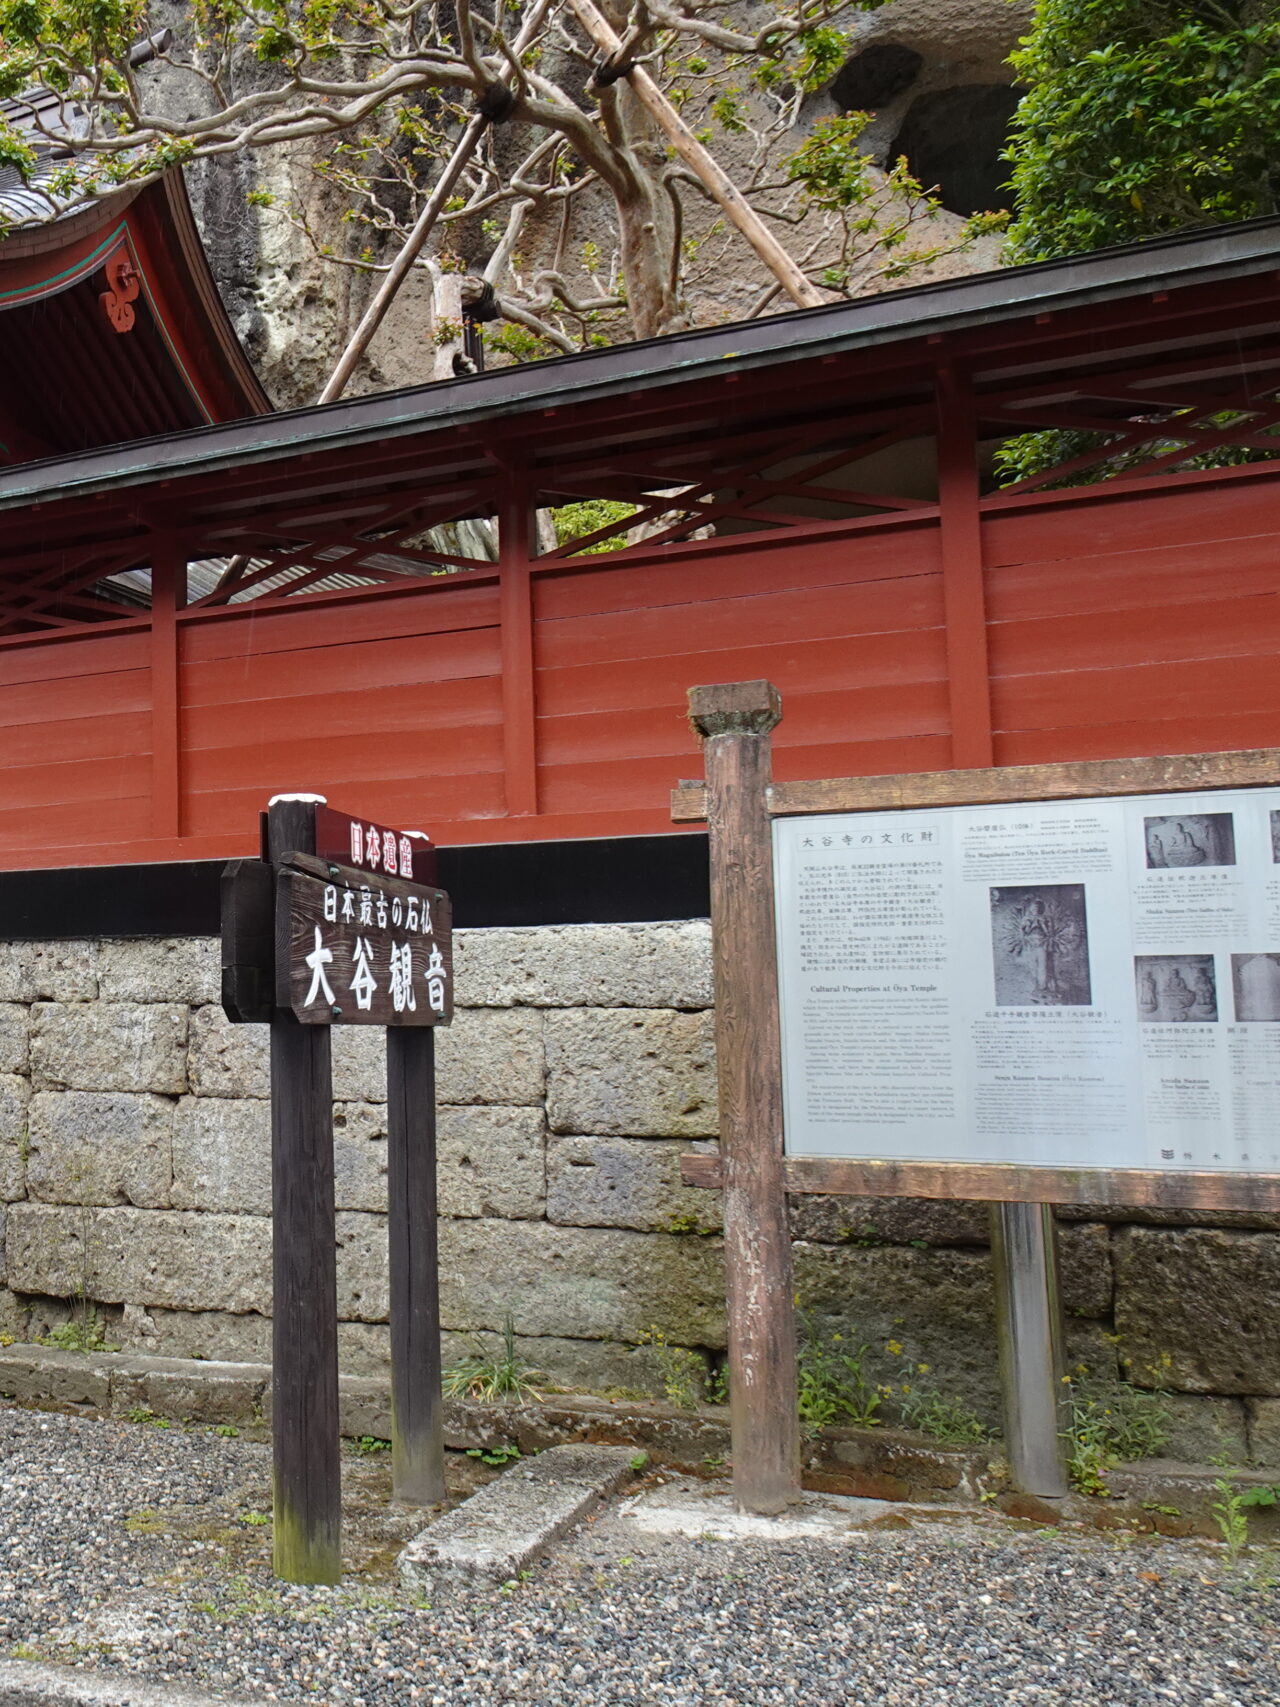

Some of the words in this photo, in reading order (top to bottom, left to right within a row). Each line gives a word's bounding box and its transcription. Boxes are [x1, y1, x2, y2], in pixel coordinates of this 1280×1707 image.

[350, 820, 414, 879] 日本遺産
[802, 831, 934, 848] 大谷寺の文化財
[323, 880, 434, 936] 日本最古の石仏
[303, 924, 448, 1013] 大谷観音
[810, 984, 840, 993] Cultural
[842, 985, 881, 995] Properties
[882, 985, 891, 993] at
[910, 984, 938, 994] Temple
